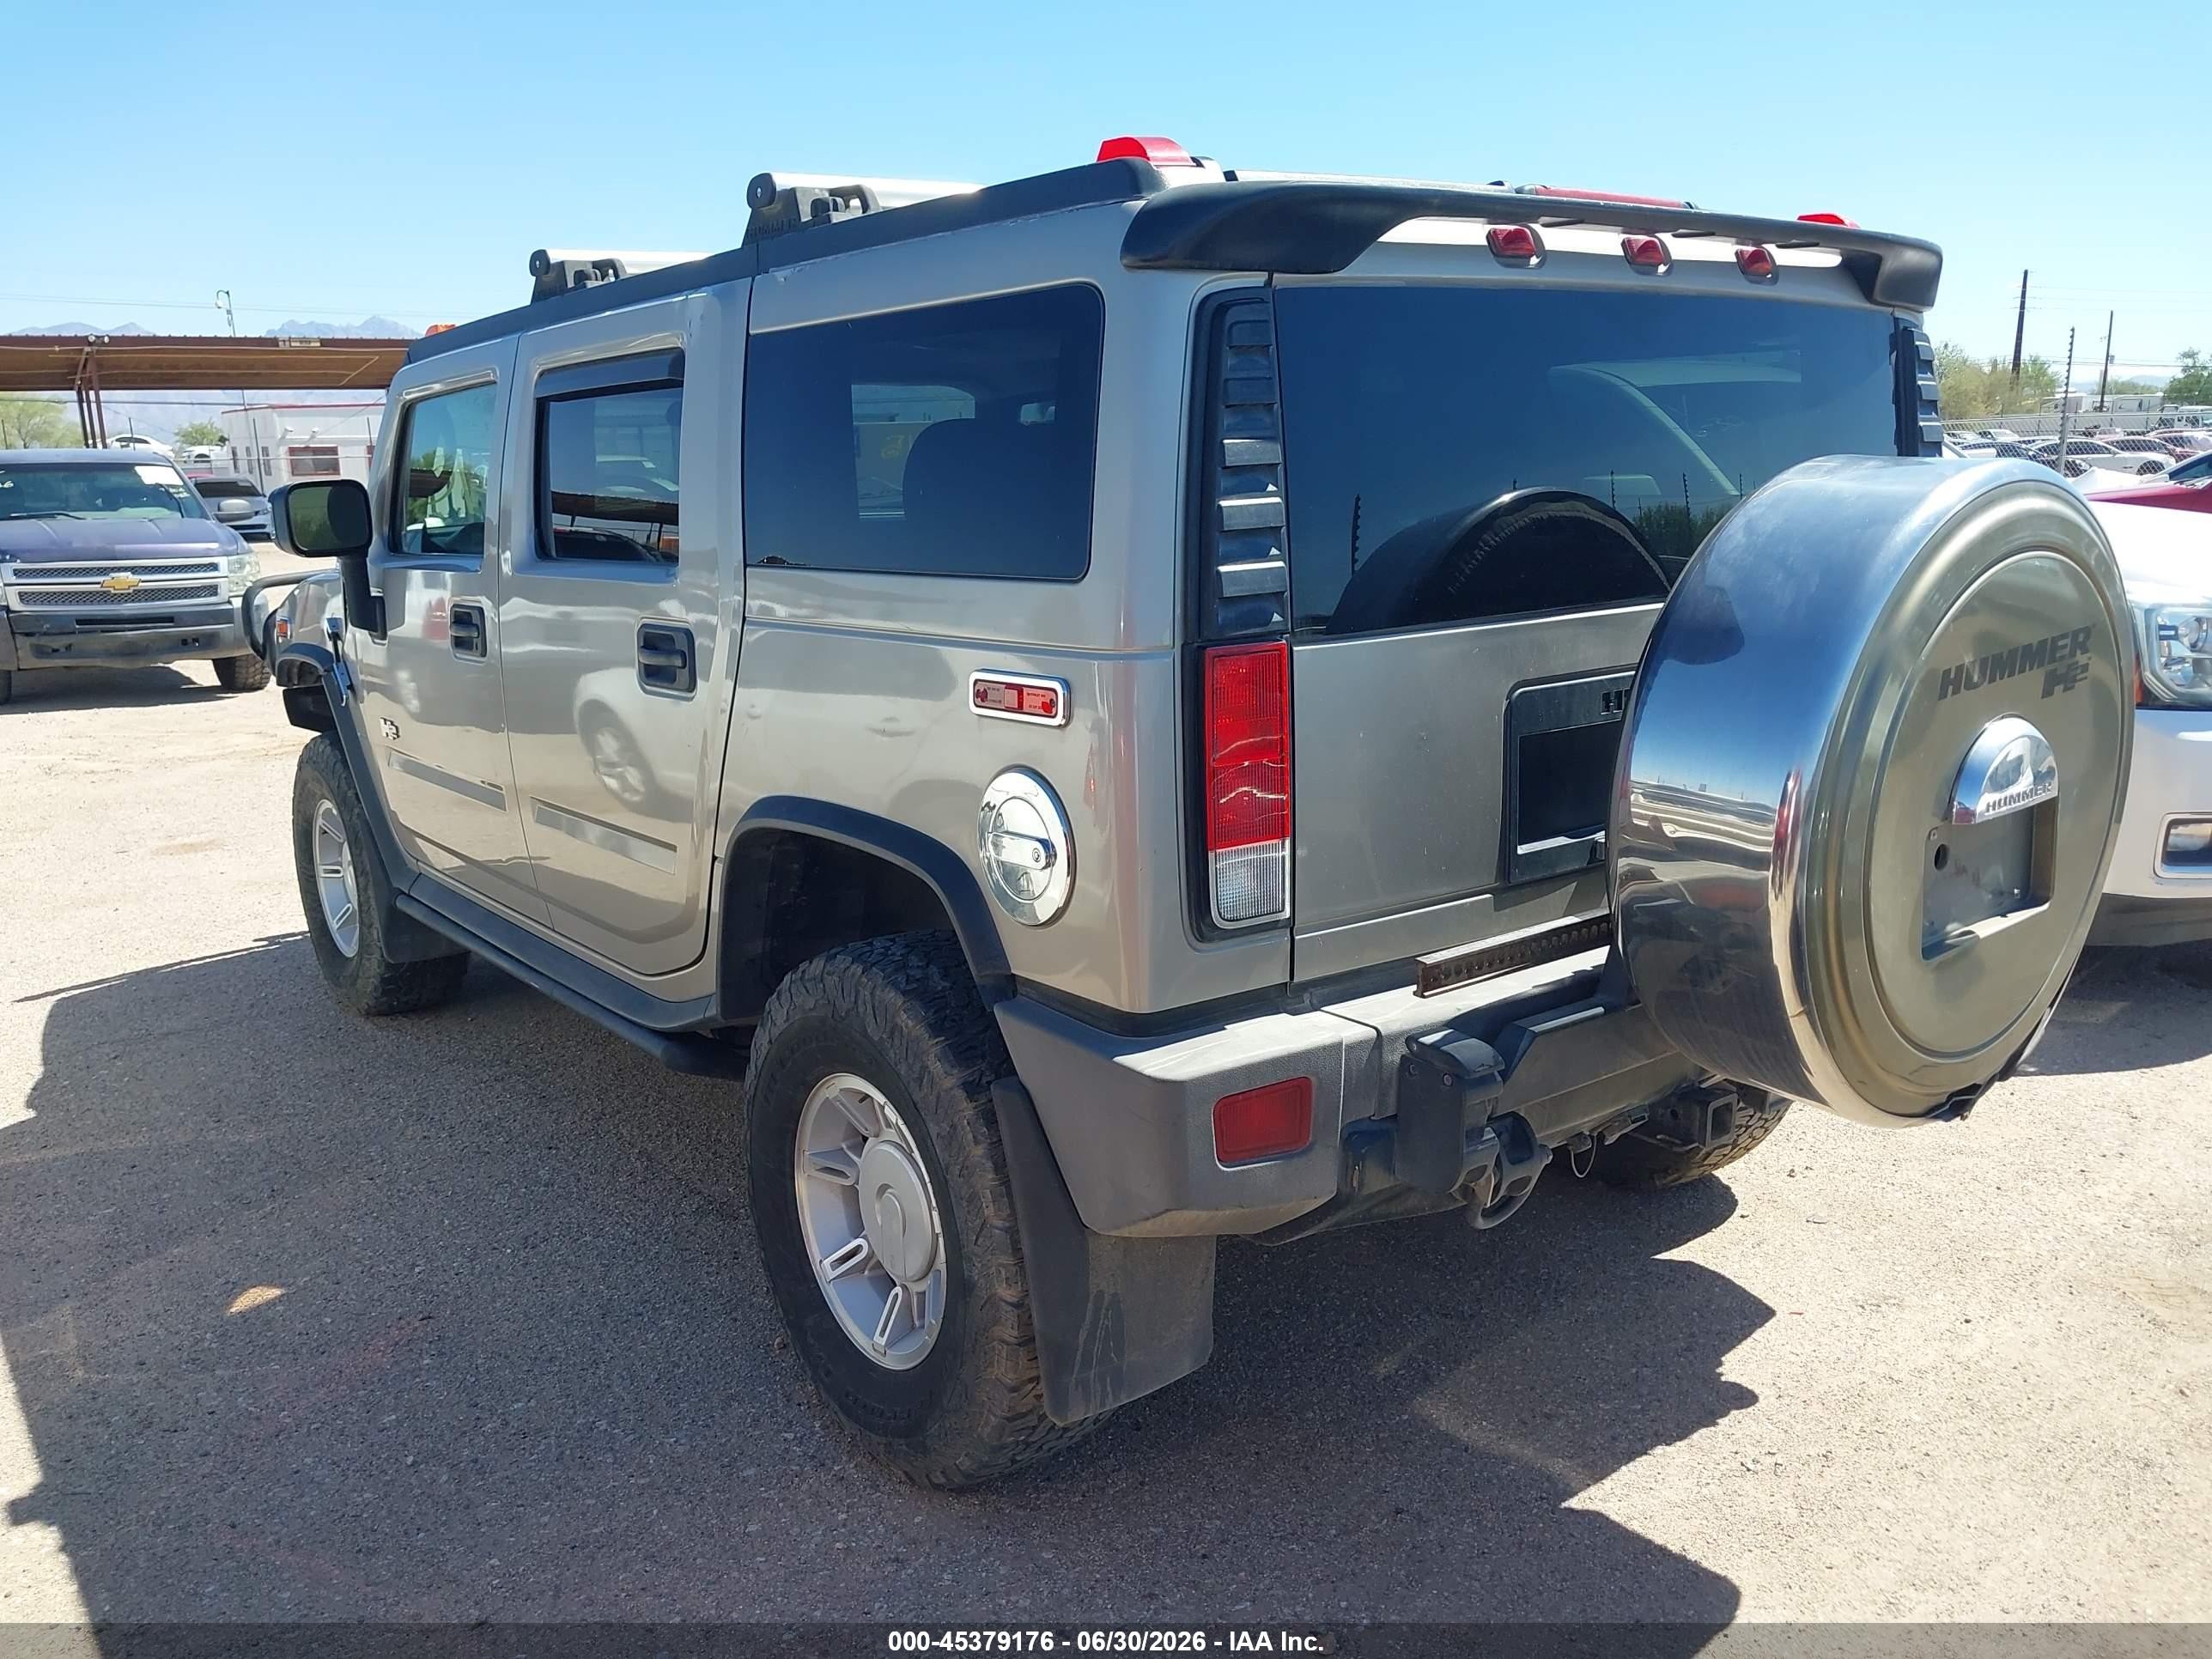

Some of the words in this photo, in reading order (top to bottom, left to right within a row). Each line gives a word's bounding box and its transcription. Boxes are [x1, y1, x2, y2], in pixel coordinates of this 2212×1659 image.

[1938, 626, 2092, 701] HUMMER
[2041, 661, 2089, 699] H2
[380, 717, 400, 740] H2
[1985, 782, 2052, 812] HUMMER
